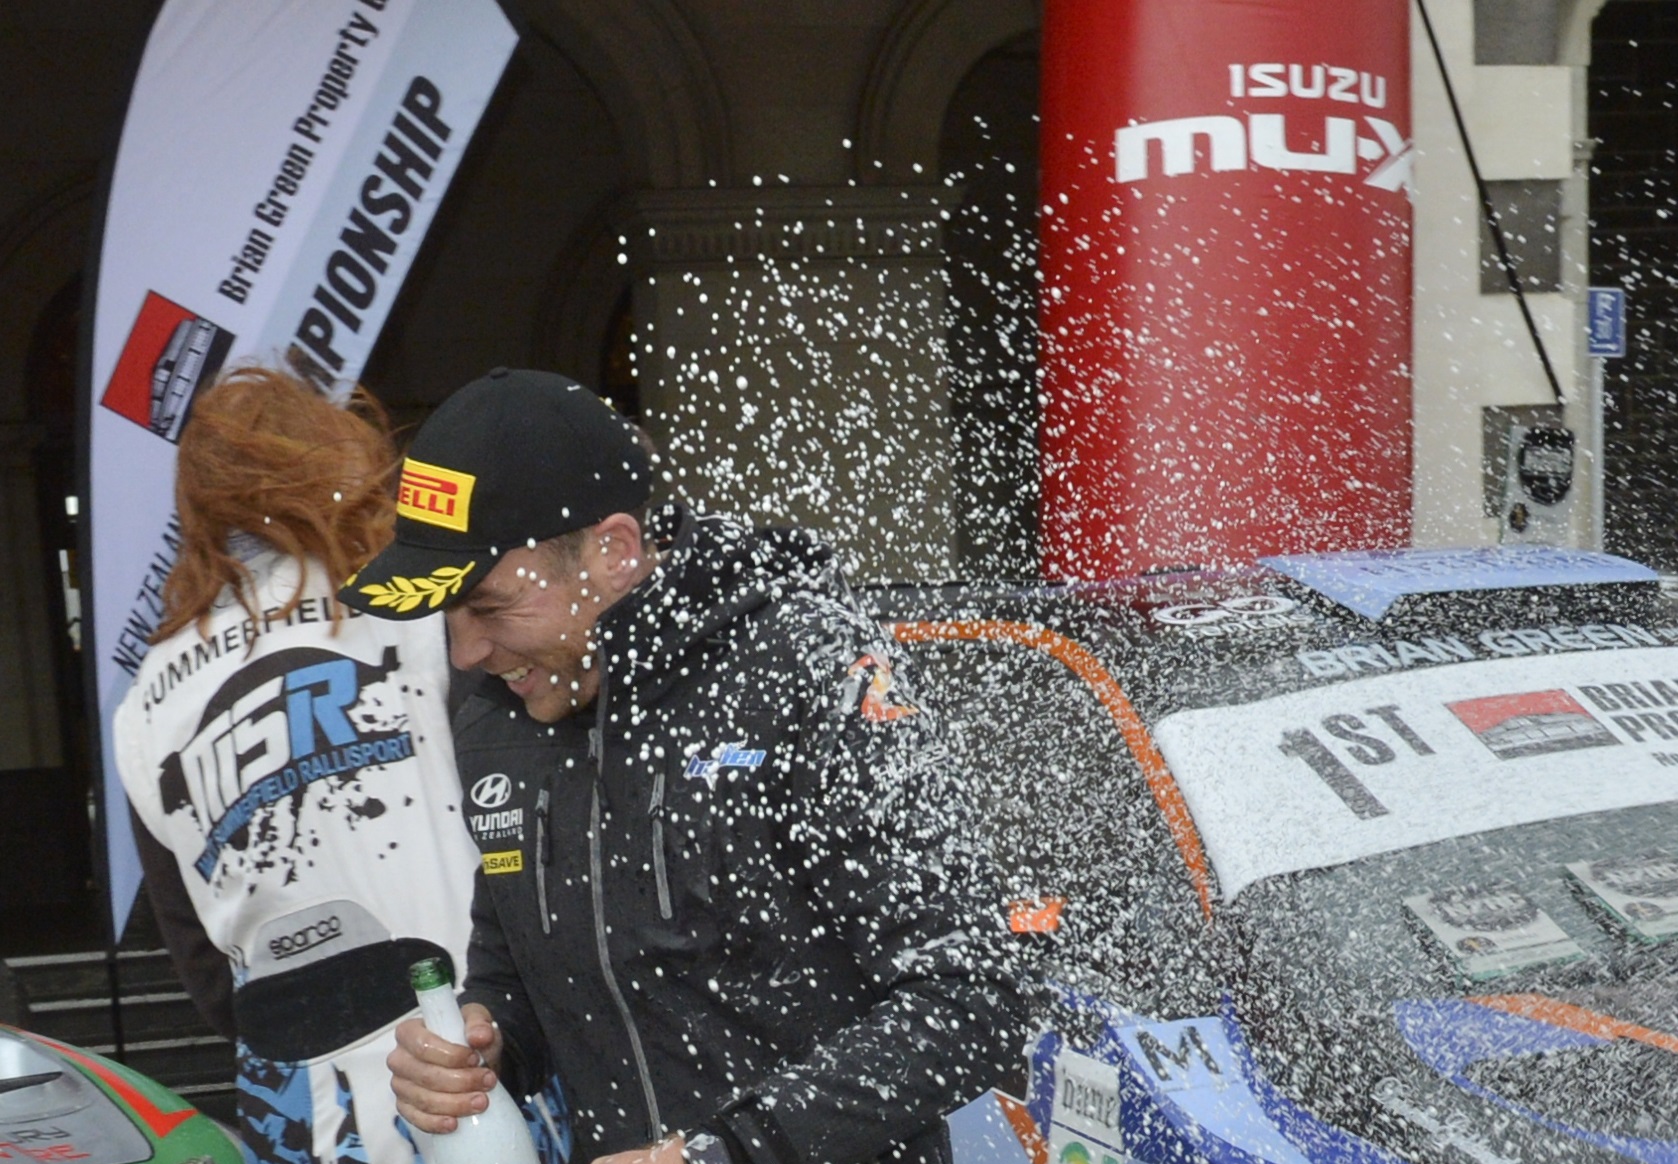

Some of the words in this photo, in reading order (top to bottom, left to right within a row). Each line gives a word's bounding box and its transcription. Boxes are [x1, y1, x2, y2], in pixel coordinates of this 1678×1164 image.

[1229, 62, 1386, 109] ISUZU
[217, 227, 275, 305] Brian
[254, 143, 315, 228] Green
[293, 11, 380, 144] Property
[398, 469, 458, 517] ELLI
[111, 607, 156, 678] NEW
[146, 512, 181, 617] ZEALAN
[1298, 637, 1475, 678] BRIAN
[1483, 624, 1666, 659] GREEN
[299, 731, 413, 786] RALLISPORT
[1277, 704, 1437, 820] 1ST
[470, 808, 523, 832] YUNDAI
[484, 855, 519, 871] nSAVE
[269, 916, 341, 956] sparco
